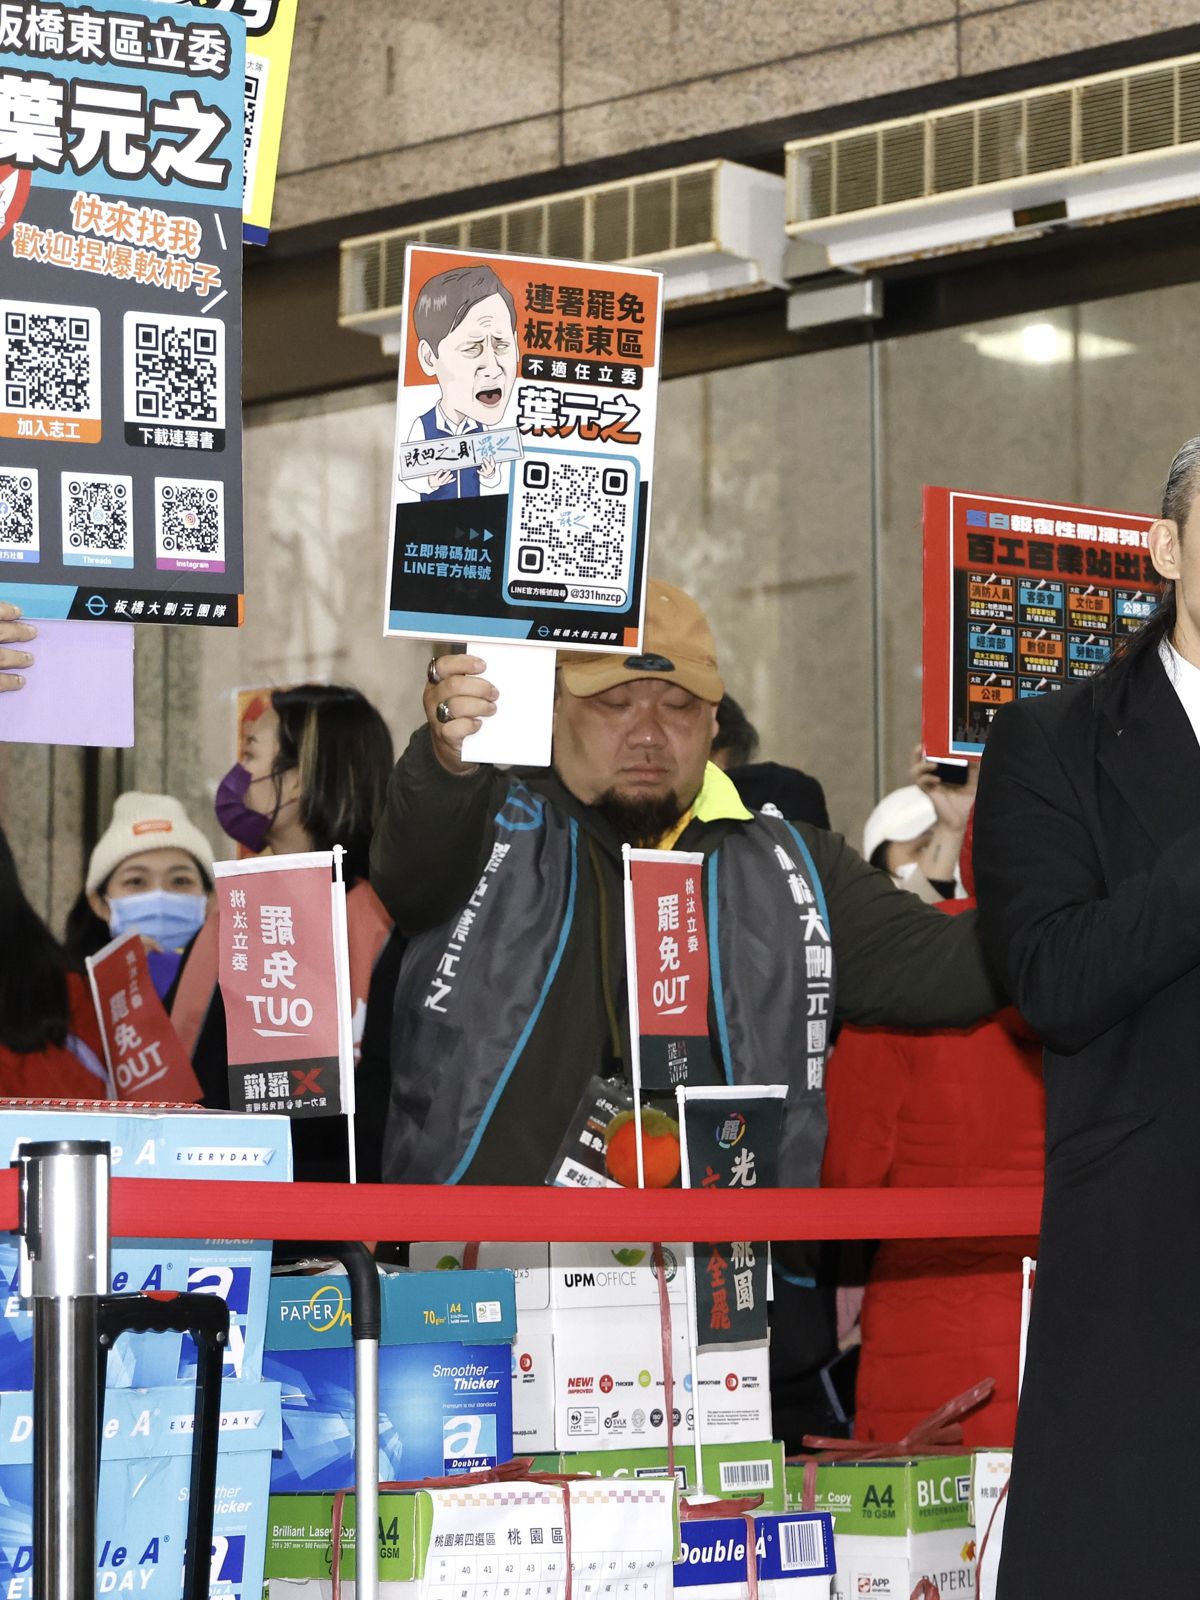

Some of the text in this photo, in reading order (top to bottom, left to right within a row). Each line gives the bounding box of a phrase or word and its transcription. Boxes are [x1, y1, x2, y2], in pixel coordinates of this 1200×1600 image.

[0, 74, 228, 183] 葉元之
[72, 193, 203, 258] 快來找我
[12, 224, 223, 297] 歡迎捏爆軟柿子
[524, 282, 646, 324] 連署罷免
[522, 318, 644, 359] 板橋東區
[527, 360, 638, 385] 不適任立委
[517, 386, 642, 444] 葉元之
[17, 418, 81, 440] 加入志工
[138, 427, 215, 451] 下載連署書
[83, 556, 112, 565] Threads
[404, 542, 492, 564] 立即掃碼加入
[176, 560, 210, 569] Instagram
[403, 561, 492, 582] LINE官方帳號
[570, 588, 622, 604] @331hnzcp
[685, 878, 699, 953] 桃汰立委
[657, 894, 681, 972] 罷免
[653, 975, 690, 1007] OUT
[116, 1041, 164, 1088] OUT
[176, 1153, 259, 1161] EVERYDAY
[564, 1271, 637, 1288] UPM OFFICE
[450, 1303, 461, 1313] A4
[432, 1363, 488, 1378] Smoother
[454, 1377, 499, 1390] Thicker
[567, 1377, 594, 1387] NEW!
[170, 1417, 250, 1430] EVEDAY
[452, 1459, 479, 1467] Double
[828, 1492, 852, 1504] Copy
[863, 1485, 894, 1508] A4
[917, 1477, 953, 1507] BLC
[874, 1509, 896, 1519] GSM
[273, 1525, 305, 1537] Brilliant
[434, 1527, 564, 1548] 桃園第四選區 桃園區
[380, 1547, 400, 1558] GSM
[680, 1539, 745, 1565] Double
[461, 1566, 471, 1574] 40
[483, 1565, 492, 1573] 41
[505, 1565, 514, 1573] 42
[526, 1564, 535, 1572] 43
[588, 1562, 597, 1570] 46
[608, 1562, 616, 1570] 47
[628, 1561, 636, 1569] 48
[872, 1578, 890, 1586] APP
